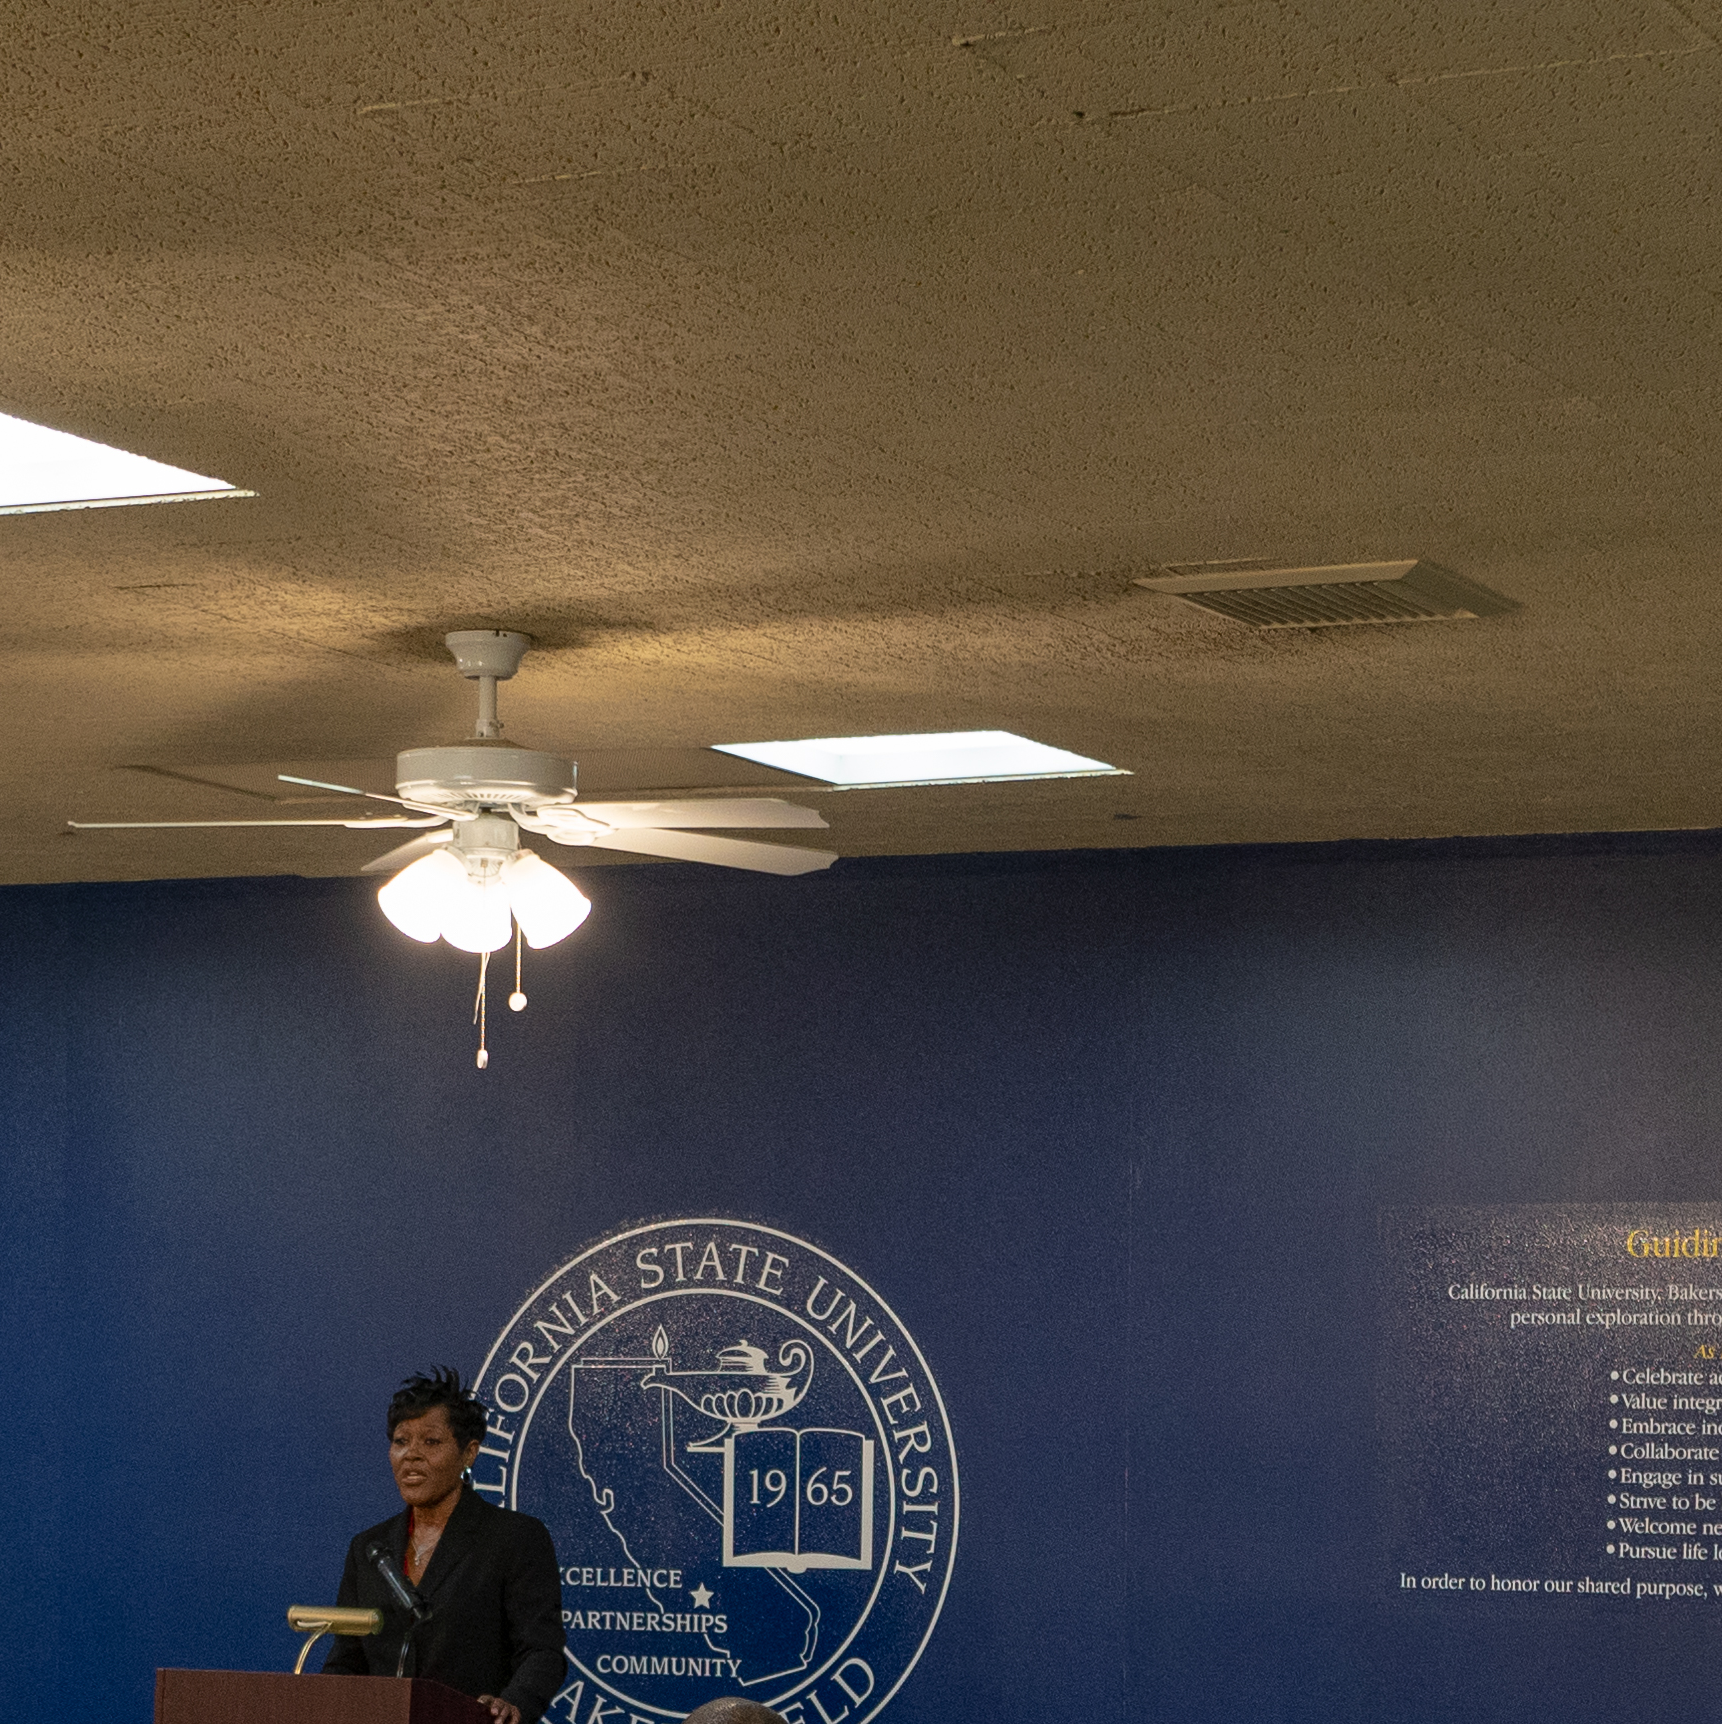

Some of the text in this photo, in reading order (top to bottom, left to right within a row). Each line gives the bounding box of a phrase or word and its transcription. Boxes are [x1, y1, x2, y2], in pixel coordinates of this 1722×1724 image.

[1448, 1284, 1527, 1300] California
[1531, 1284, 1572, 1301] State
[1510, 1309, 1581, 1331] personal
[1585, 1309, 1682, 1331] exploration
[1693, 1345, 1715, 1360] As
[1621, 1369, 1704, 1386] Celebrate
[1621, 1393, 1668, 1410] Value
[472, 1240, 939, 1595] LIFORNIA STATE UNIVERSITY
[1621, 1419, 1696, 1436] Embrace
[1620, 1443, 1720, 1461] Collaborate
[748, 1467, 853, 1508] 19 65
[1619, 1469, 1683, 1491] Engage
[1687, 1471, 1705, 1486] in
[1619, 1494, 1667, 1511] Strive
[1671, 1497, 1690, 1511] to
[1694, 1495, 1717, 1512] be
[1618, 1518, 1697, 1536] Welcome
[1618, 1543, 1678, 1560] Pursue
[1682, 1544, 1708, 1561] life
[559, 1567, 682, 1588] CELLENCE
[1399, 1572, 1417, 1589] In
[1420, 1572, 1467, 1591] order
[1469, 1576, 1486, 1591] to
[1490, 1574, 1540, 1592] honor
[1543, 1580, 1574, 1593] our
[1577, 1576, 1631, 1595] shared
[1635, 1583, 1709, 1602] purpose,
[561, 1609, 728, 1634] PARTNERSHIPS
[596, 1654, 742, 1678] COMMUNITY
